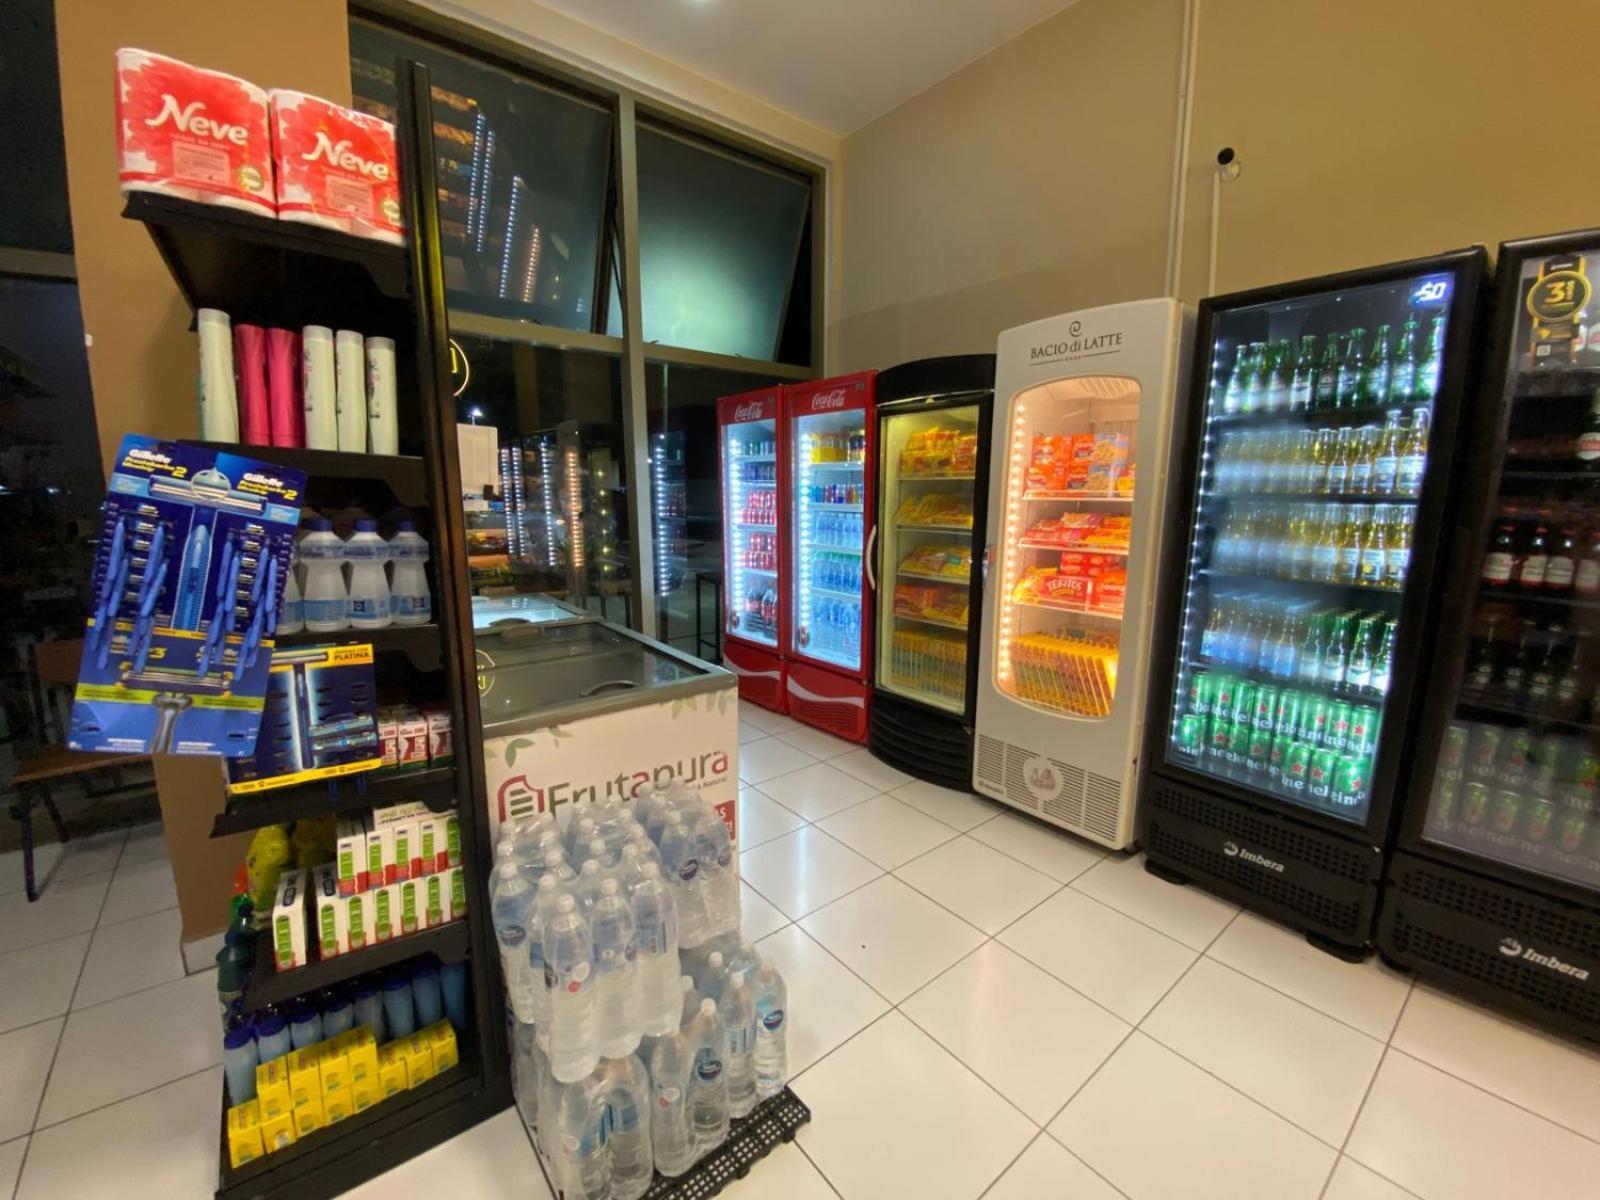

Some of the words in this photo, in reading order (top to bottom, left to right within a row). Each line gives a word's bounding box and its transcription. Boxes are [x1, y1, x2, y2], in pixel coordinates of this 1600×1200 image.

[145, 94, 248, 146] Neve
[302, 132, 389, 180] Neve
[1544, 281, 1566, 304] 3
[1030, 344, 1068, 360] BACIO
[1069, 341, 1082, 352] di
[1083, 332, 1123, 350] LATTE
[812, 389, 846, 410] Coca-Cola
[735, 401, 763, 421] Coca-Cola
[129, 449, 172, 463] Gillette
[171, 466, 188, 478] 2
[243, 473, 284, 487] Gillette
[283, 489, 298, 501] 2
[334, 651, 370, 661] PLATINA
[1238, 847, 1285, 873] Imbera
[1522, 948, 1589, 981] Imbera
